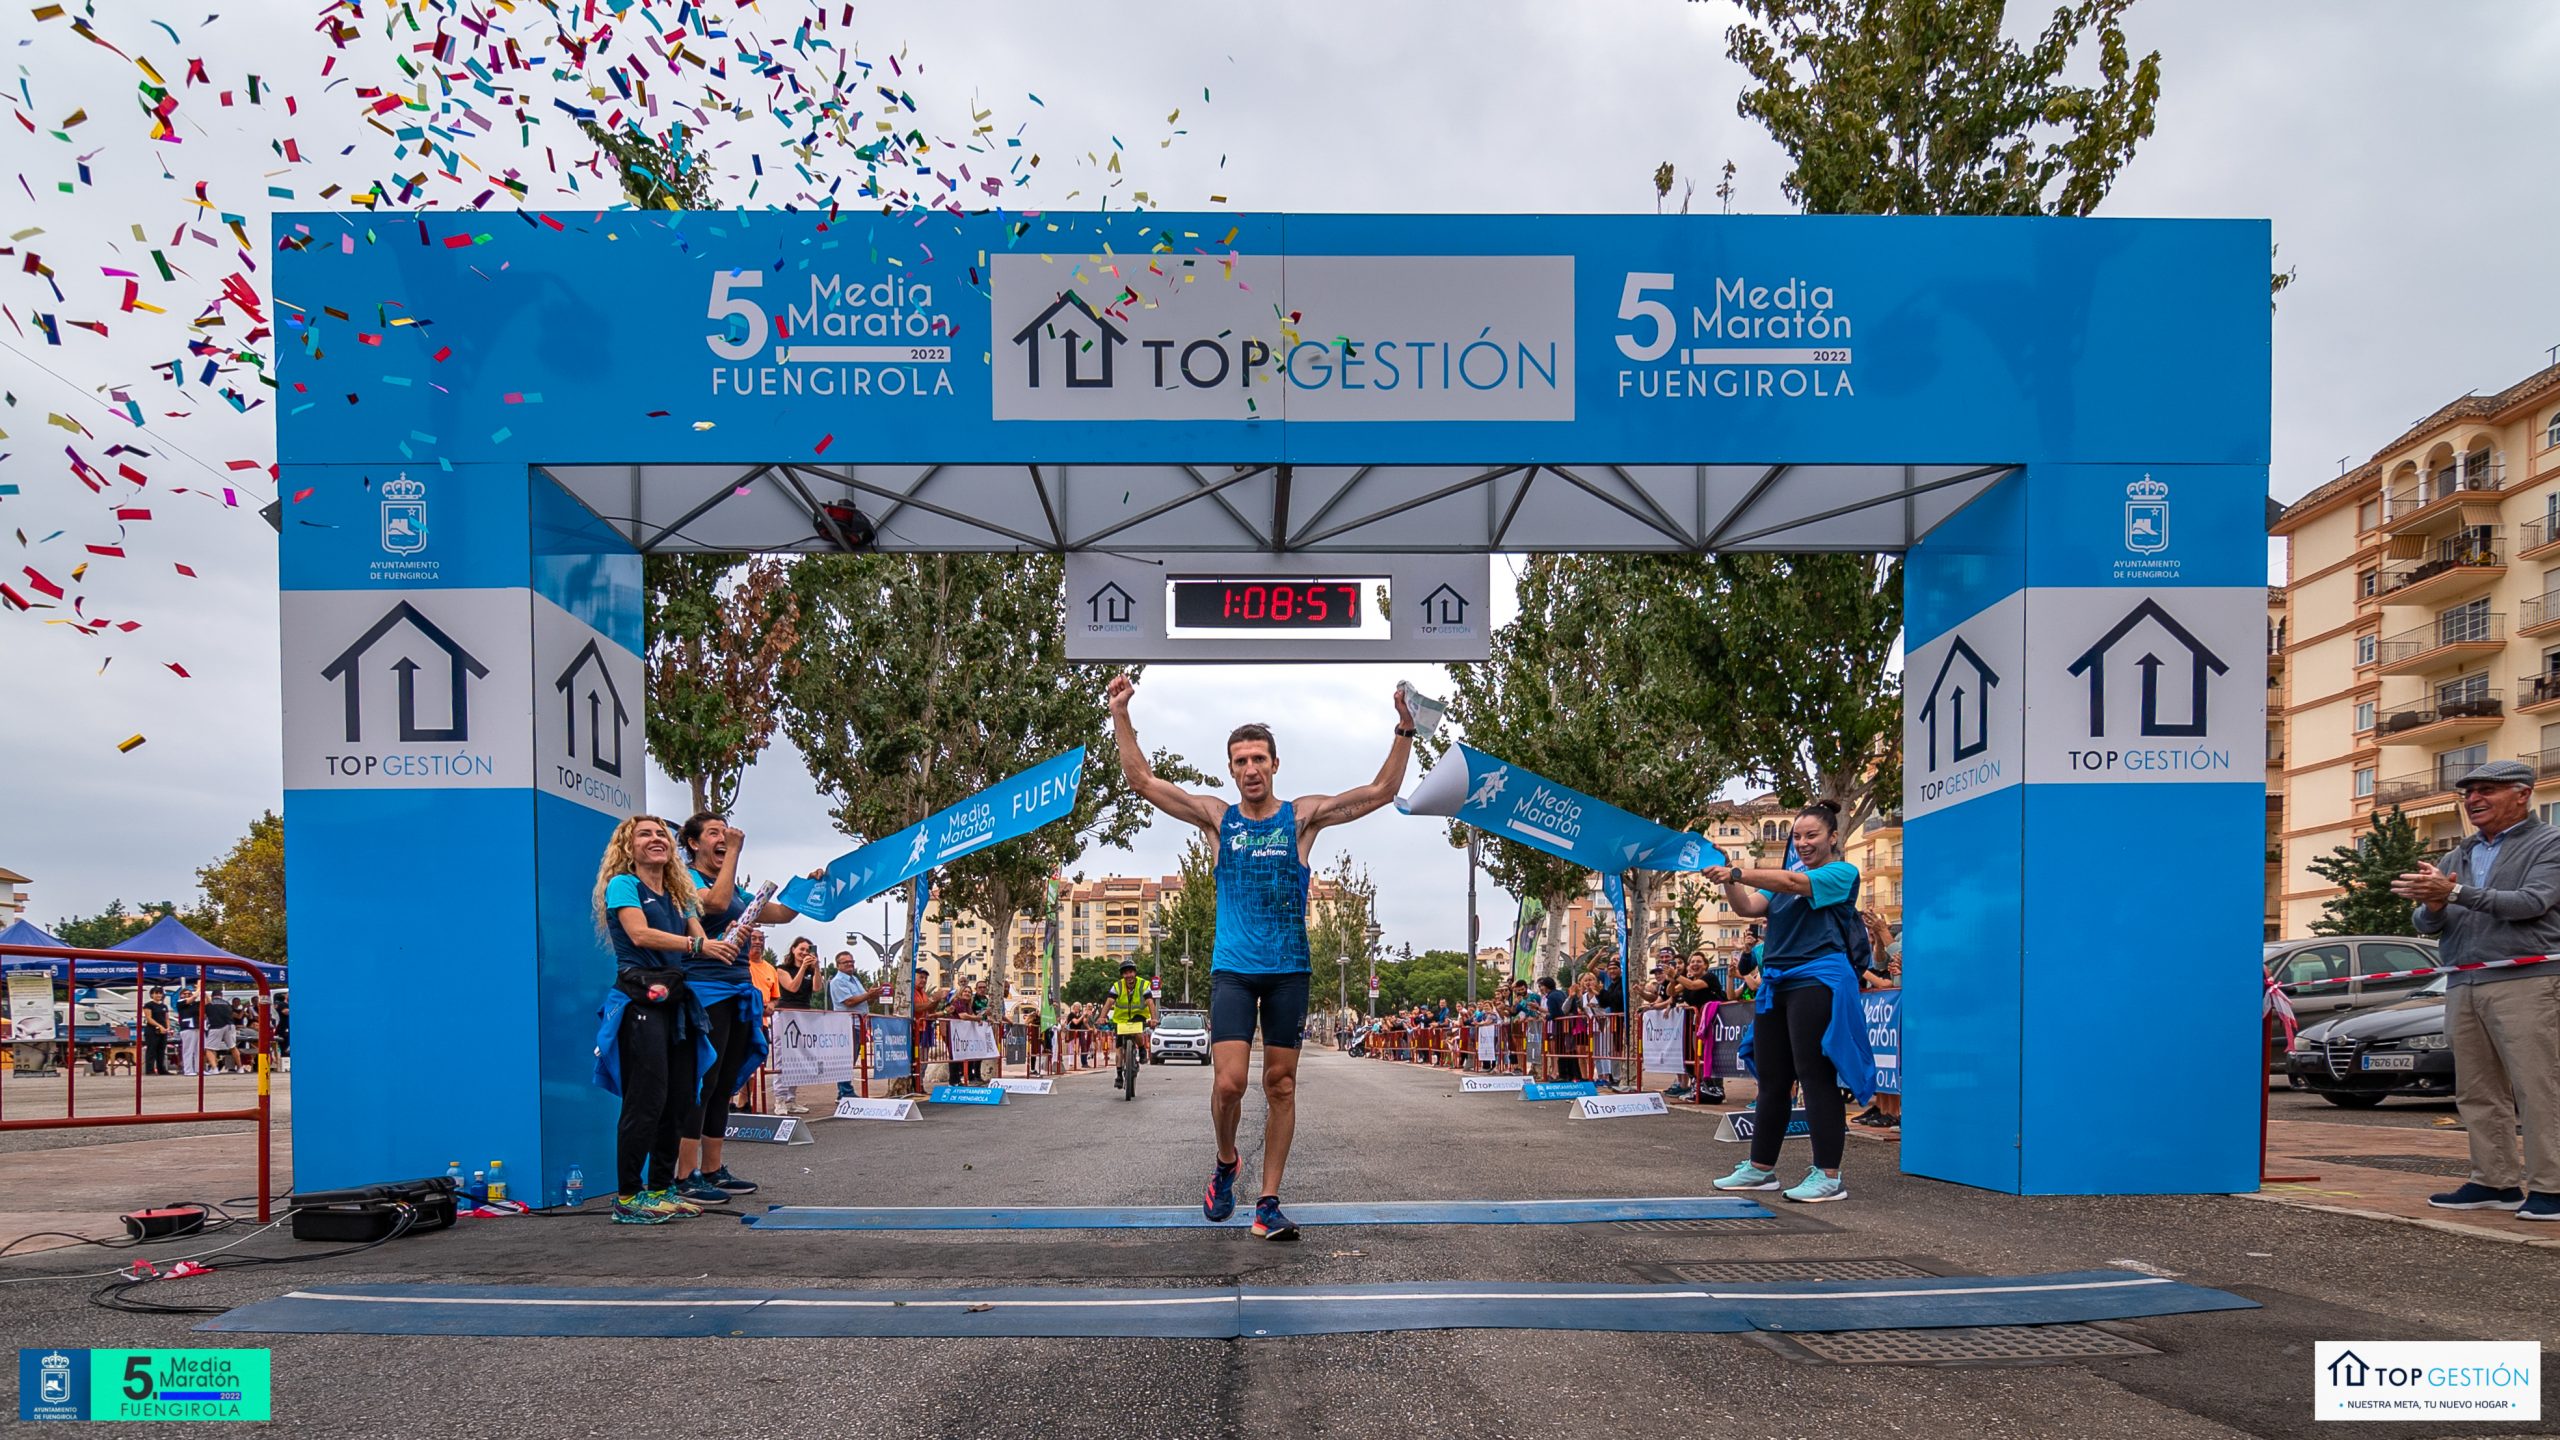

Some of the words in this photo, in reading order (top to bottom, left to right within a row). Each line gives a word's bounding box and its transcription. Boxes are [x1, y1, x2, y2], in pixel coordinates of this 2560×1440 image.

[811, 273, 932, 308] Media
[1717, 277, 1834, 310] Media
[788, 302, 951, 338] Maratón
[1693, 306, 1853, 339] Maratón
[910, 348, 946, 360] 2022
[1143, 340, 1270, 388] TOP
[1287, 326, 1556, 391] GESTIÓN
[1813, 350, 1848, 362] 2022
[713, 367, 954, 396] FUENGIROLA
[1619, 370, 1855, 398] FUENGIROLA
[370, 562, 440, 570] AYUNTAMIENTO
[370, 572, 382, 580] DE
[384, 572, 439, 581] FUENGIROLA
[2113, 560, 2181, 568] AYUNTAMIENTO
[2113, 570, 2125, 578] DE
[2127, 570, 2180, 579] FUENGIROLA
[1224, 586, 1357, 621] 1:08:57
[1087, 624, 1104, 632] TOP
[1104, 622, 1138, 632] GESTIÓN
[1421, 625, 1437, 634] TOP
[1438, 624, 1471, 634] GESTIÓN
[326, 756, 378, 776] TOP
[383, 749, 492, 776] GESTIÓN
[2069, 750, 2119, 770] TOP
[2124, 744, 2230, 770] GESTIÓN
[557, 765, 583, 791] TOP
[584, 774, 631, 811] GESTIÓN
[1920, 784, 1944, 803] TOP
[1945, 758, 2001, 796] GESTIÓN
[949, 803, 990, 828] Media
[1530, 785, 1582, 821] Media
[1513, 796, 1581, 838] Maratón
[940, 816, 995, 847] Maratón
[1252, 849, 1287, 857] Atletismo
[803, 1034, 818, 1049] TOP
[1724, 1025, 1741, 1042] TOP
[2370, 1058, 2391, 1067] 7676
[2393, 1058, 2410, 1067] CVZ
[849, 1106, 864, 1115] TOP
[1600, 1105, 1616, 1114] TOP
[724, 1126, 739, 1137] OP
[737, 1126, 774, 1139] GESTIÓN
